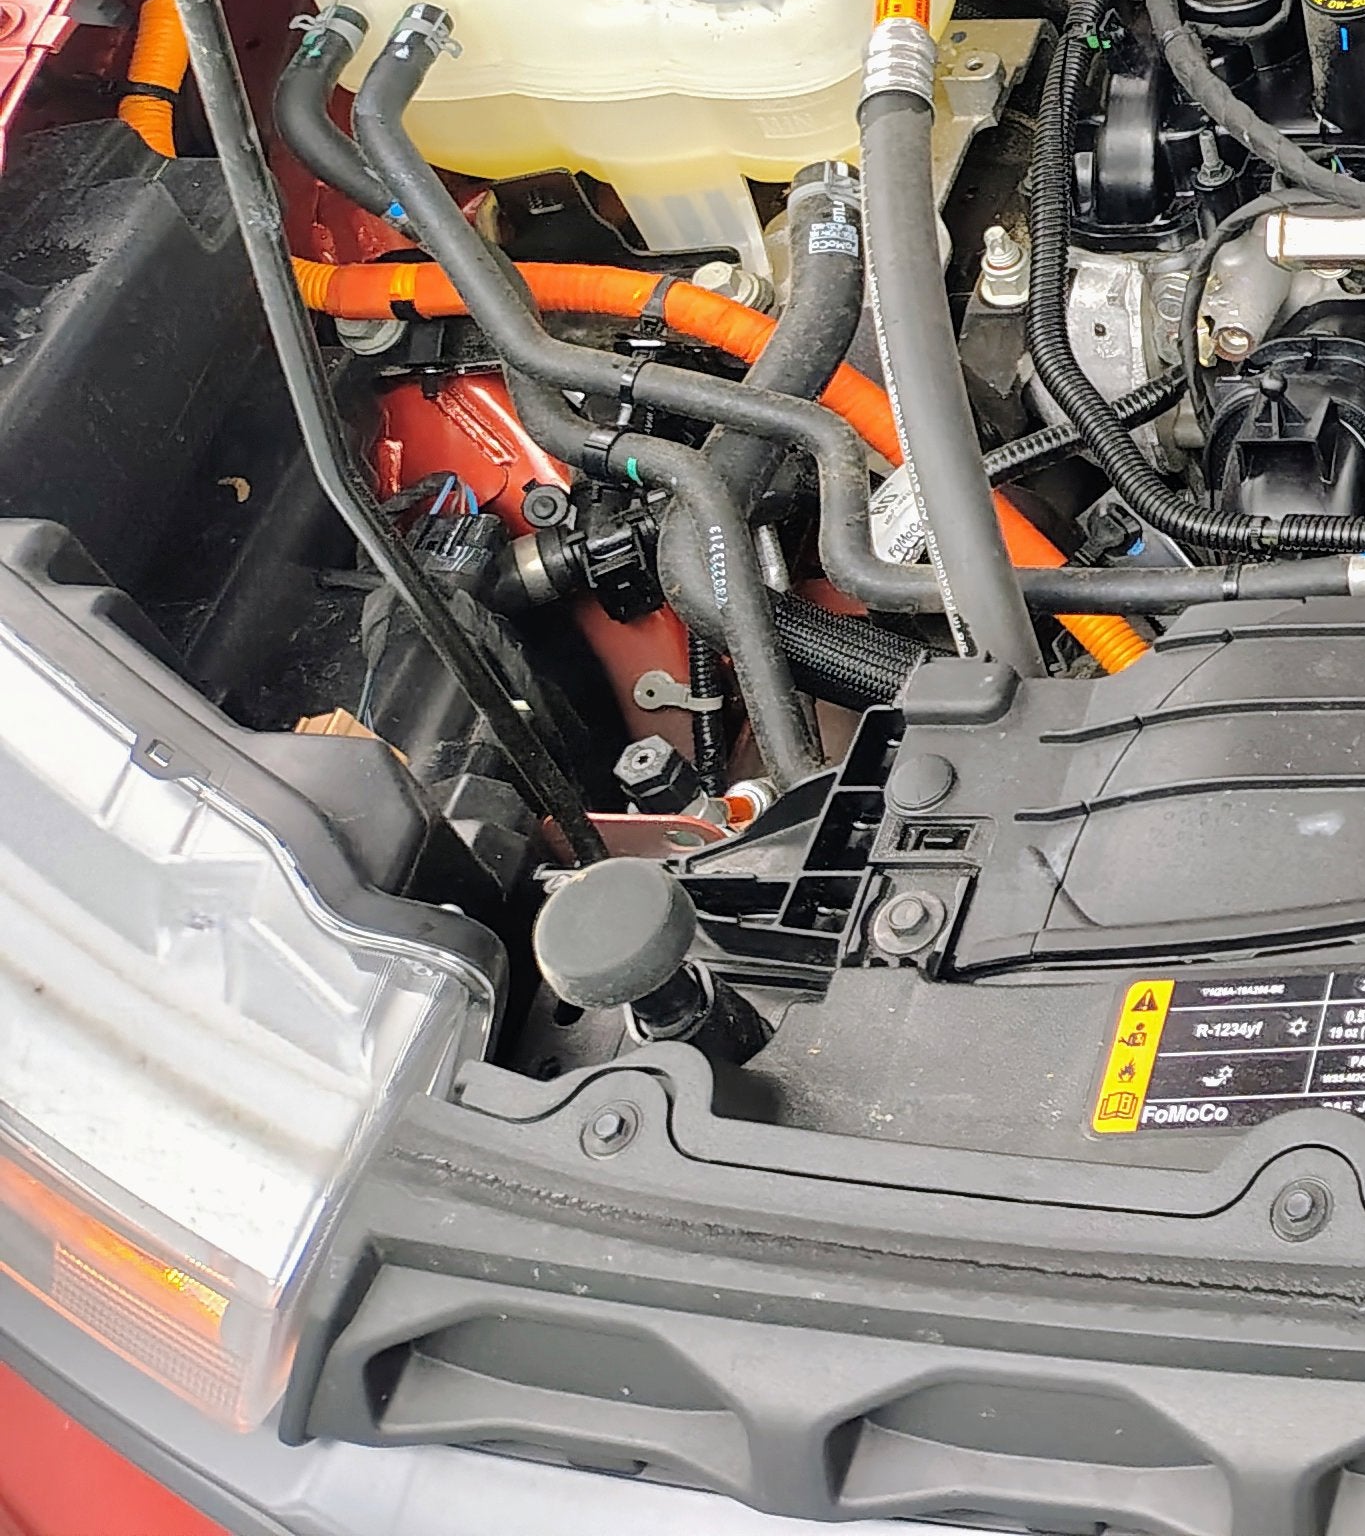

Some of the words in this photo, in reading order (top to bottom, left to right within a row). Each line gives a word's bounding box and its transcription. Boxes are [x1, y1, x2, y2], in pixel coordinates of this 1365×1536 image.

[1195, 1020, 1264, 1039] R-1234yf
[1345, 1028, 1358, 1039] oz
[1140, 1103, 1229, 1123] FoMoCo
